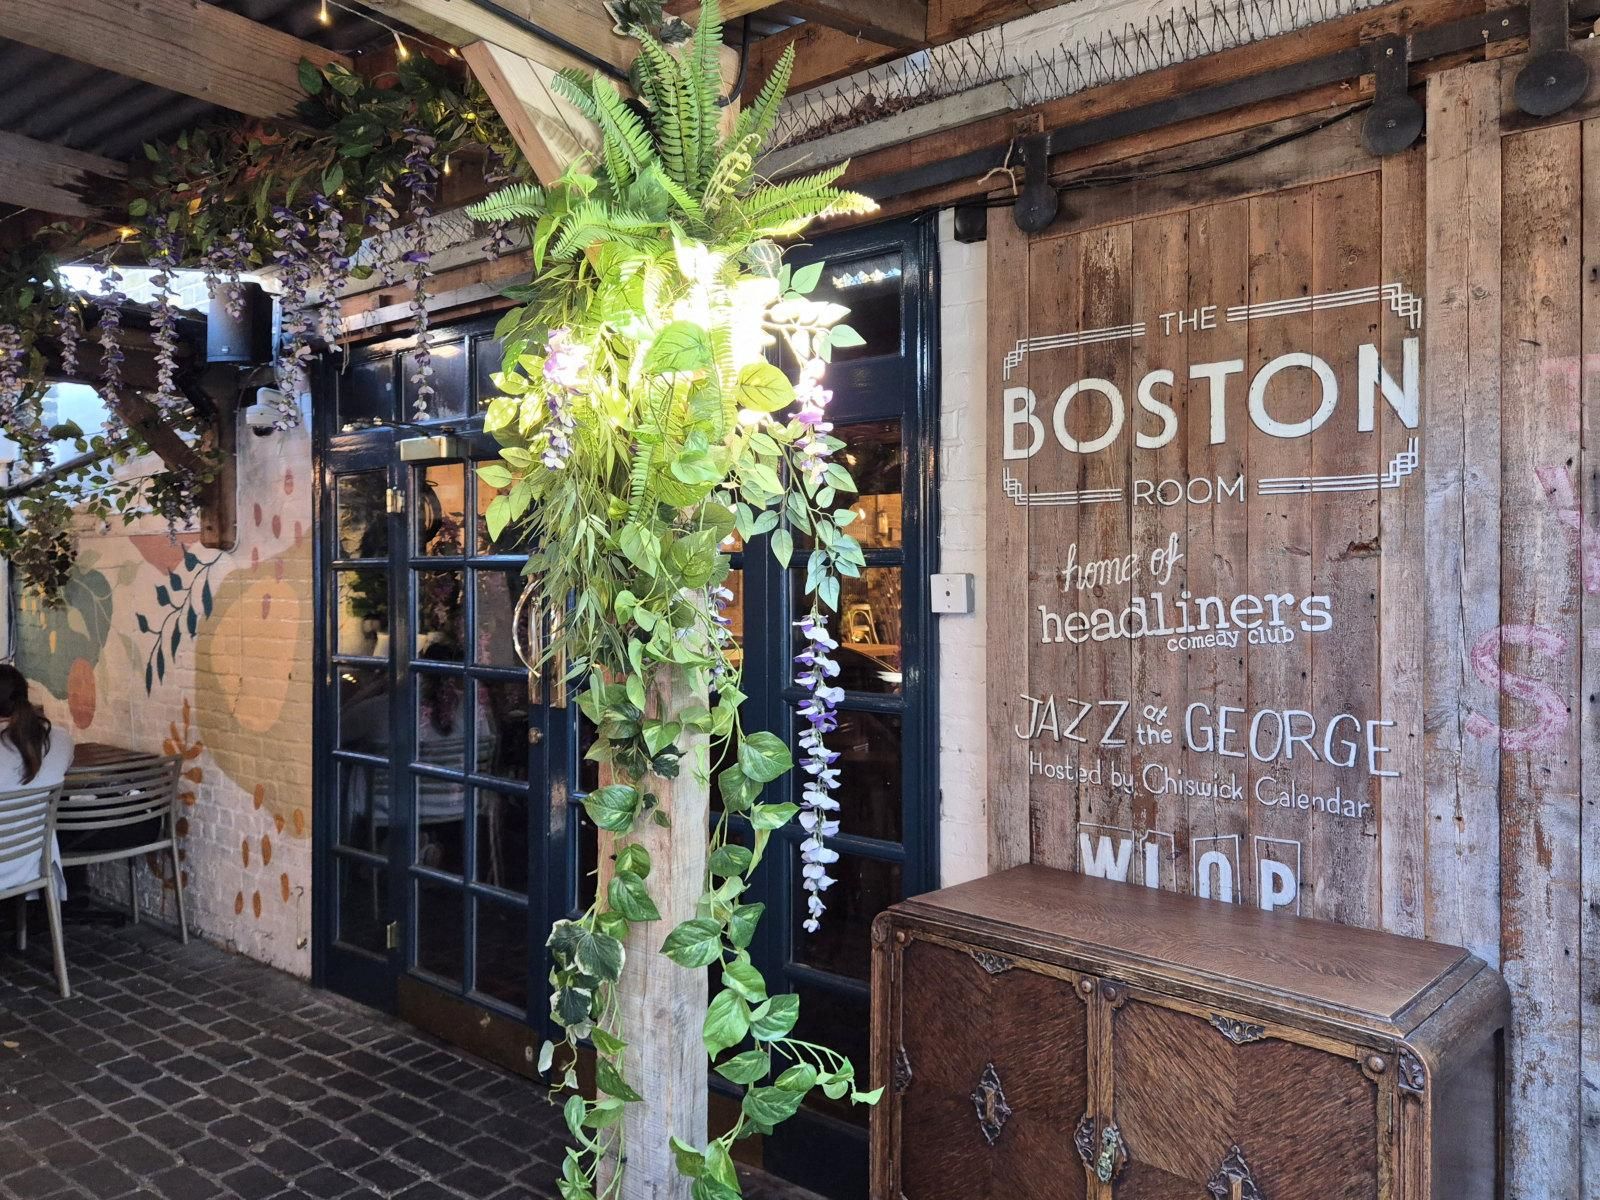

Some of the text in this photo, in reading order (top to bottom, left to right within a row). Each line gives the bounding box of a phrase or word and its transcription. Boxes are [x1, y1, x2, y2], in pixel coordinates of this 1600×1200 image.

[1158, 305, 1218, 336] THE
[1003, 337, 1420, 461] BOSTON
[1133, 474, 1245, 507] ROOM
[1062, 532, 1184, 592] home of
[1038, 591, 1333, 645] headliners
[1166, 625, 1295, 653] comedy club
[1014, 693, 1401, 778] JAZZ at the GEORGE
[1028, 750, 1371, 819] Hosted by Chiswick Calendar
